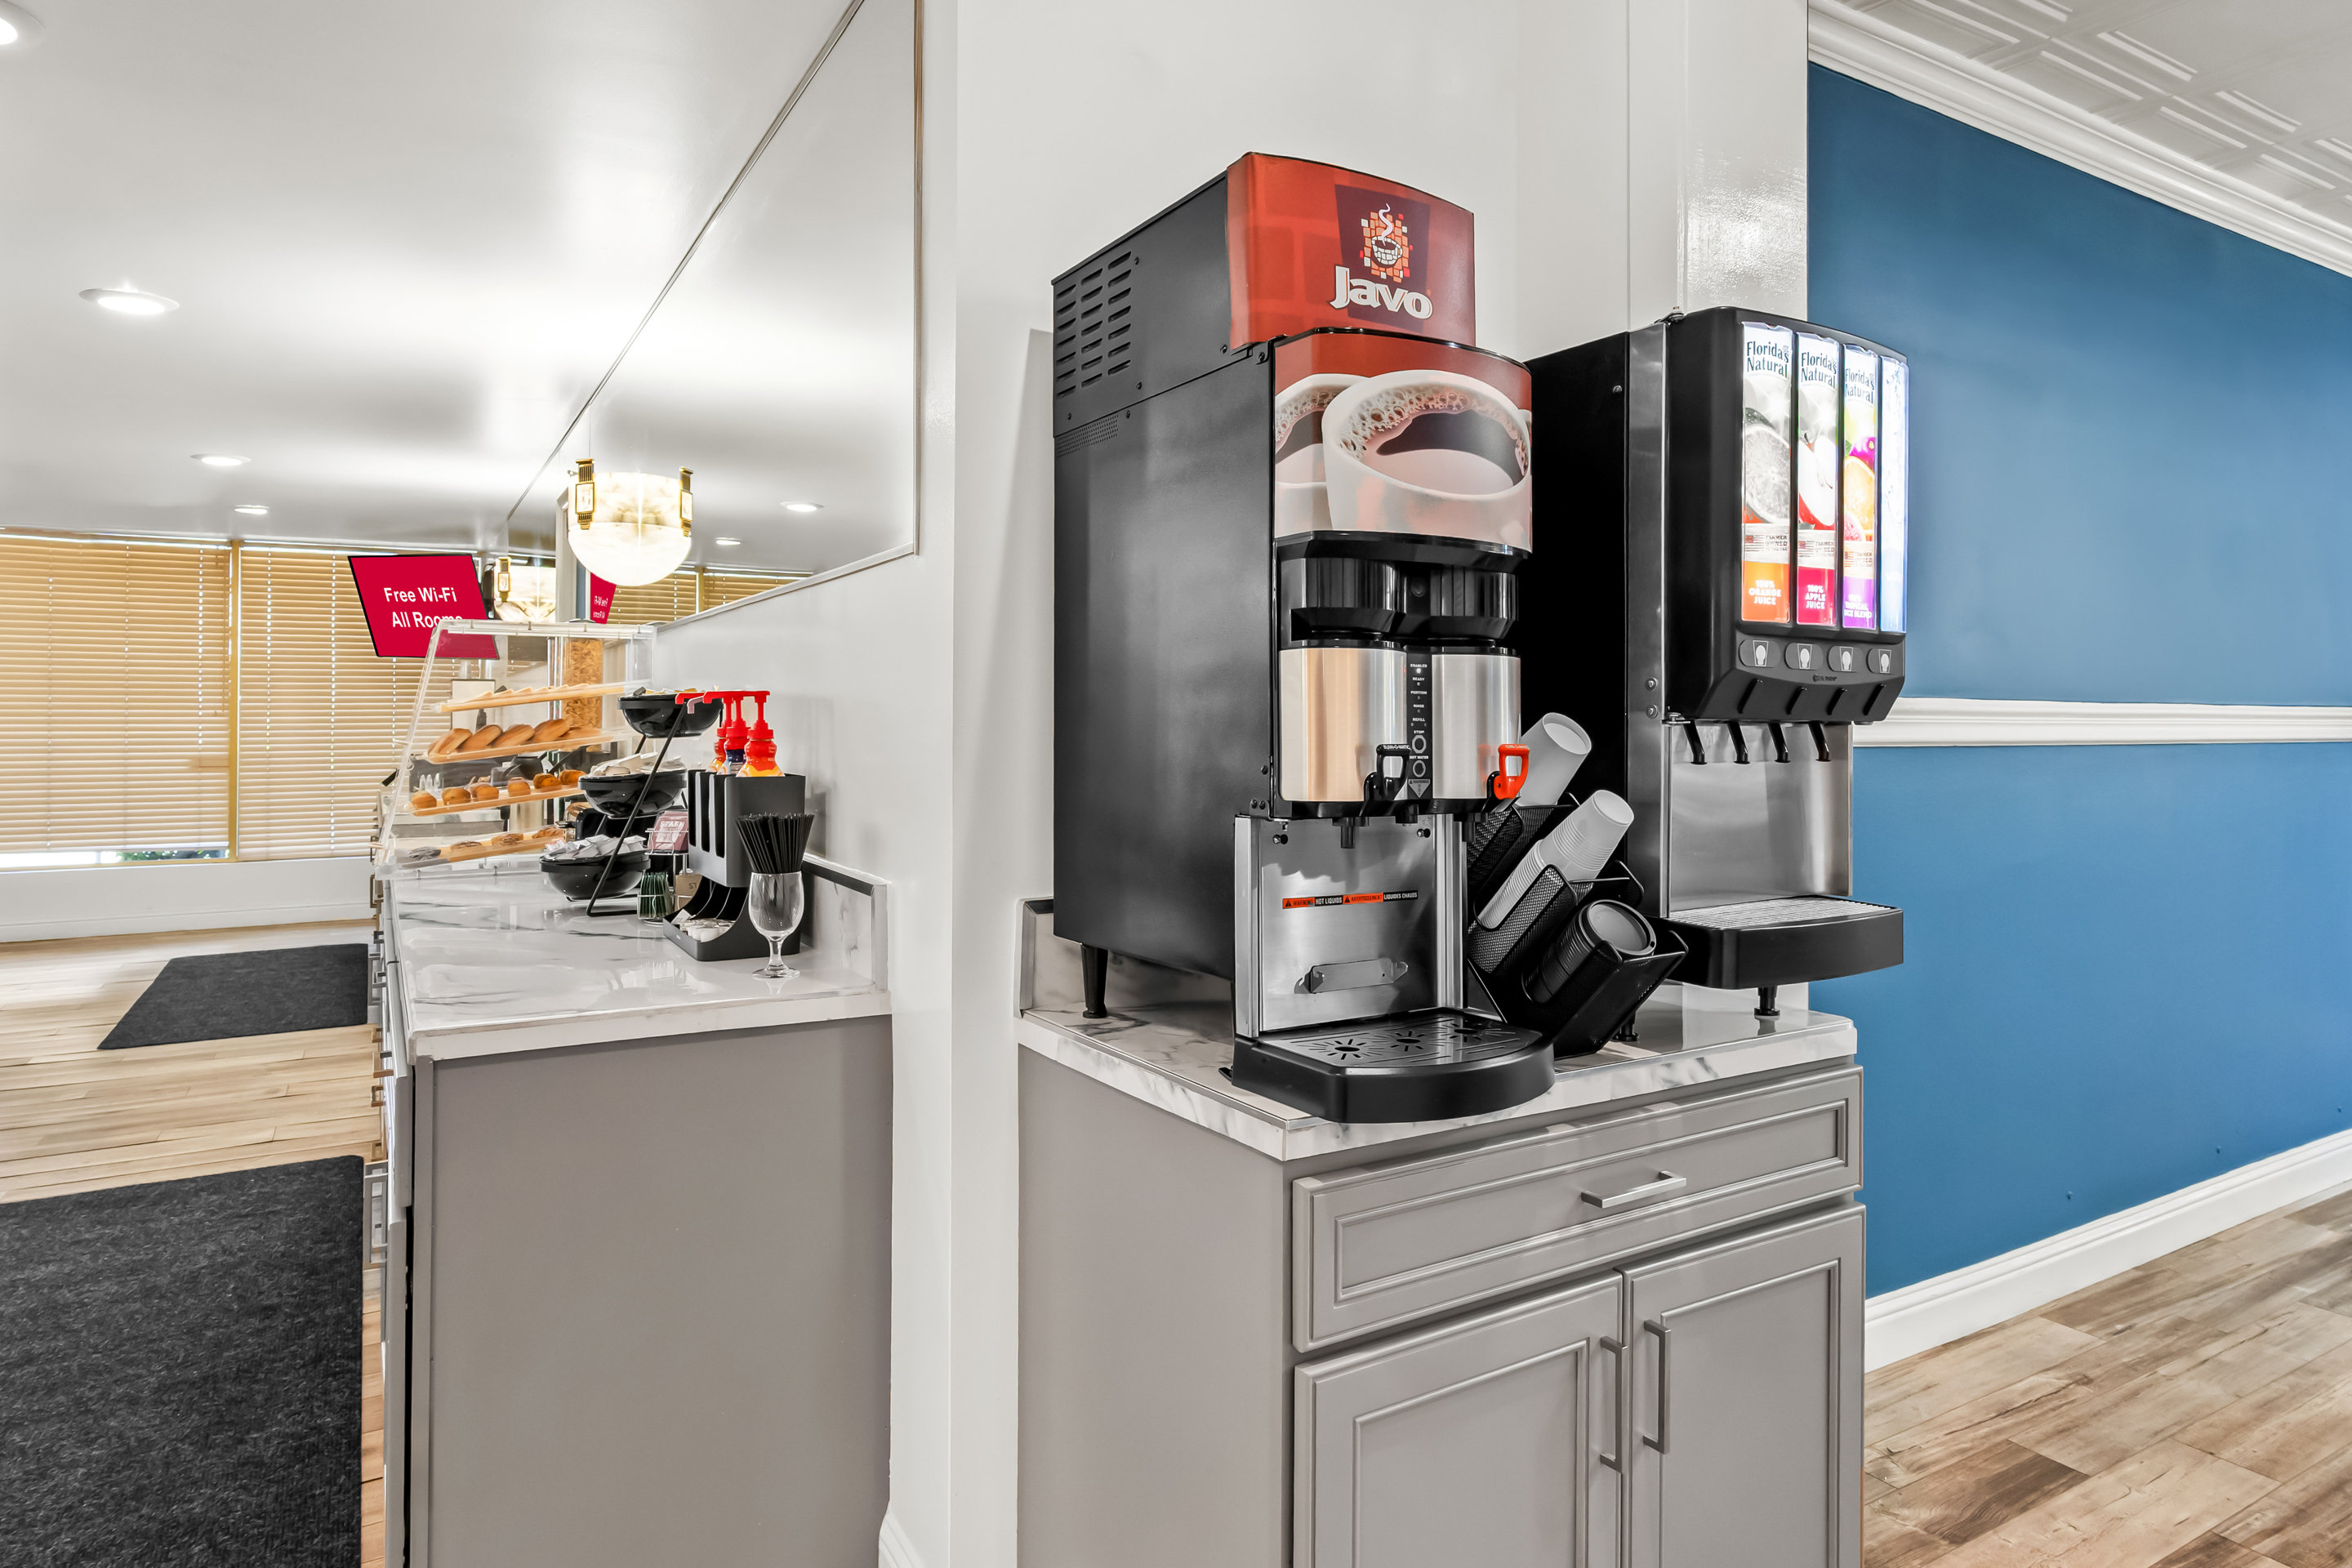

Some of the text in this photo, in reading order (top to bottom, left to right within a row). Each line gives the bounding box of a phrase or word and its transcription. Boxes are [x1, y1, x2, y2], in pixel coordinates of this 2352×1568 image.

[1330, 265, 1433, 319] Javo
[1747, 356, 1788, 378] Natural
[1801, 367, 1836, 389] Natural
[1845, 383, 1873, 404] Natural
[384, 587, 457, 603] Free Wi-Fi
[1753, 596, 1776, 605] JUICE
[1805, 593, 1826, 602] APPLE
[1806, 601, 1825, 609] JUICE
[392, 612, 411, 628] All
